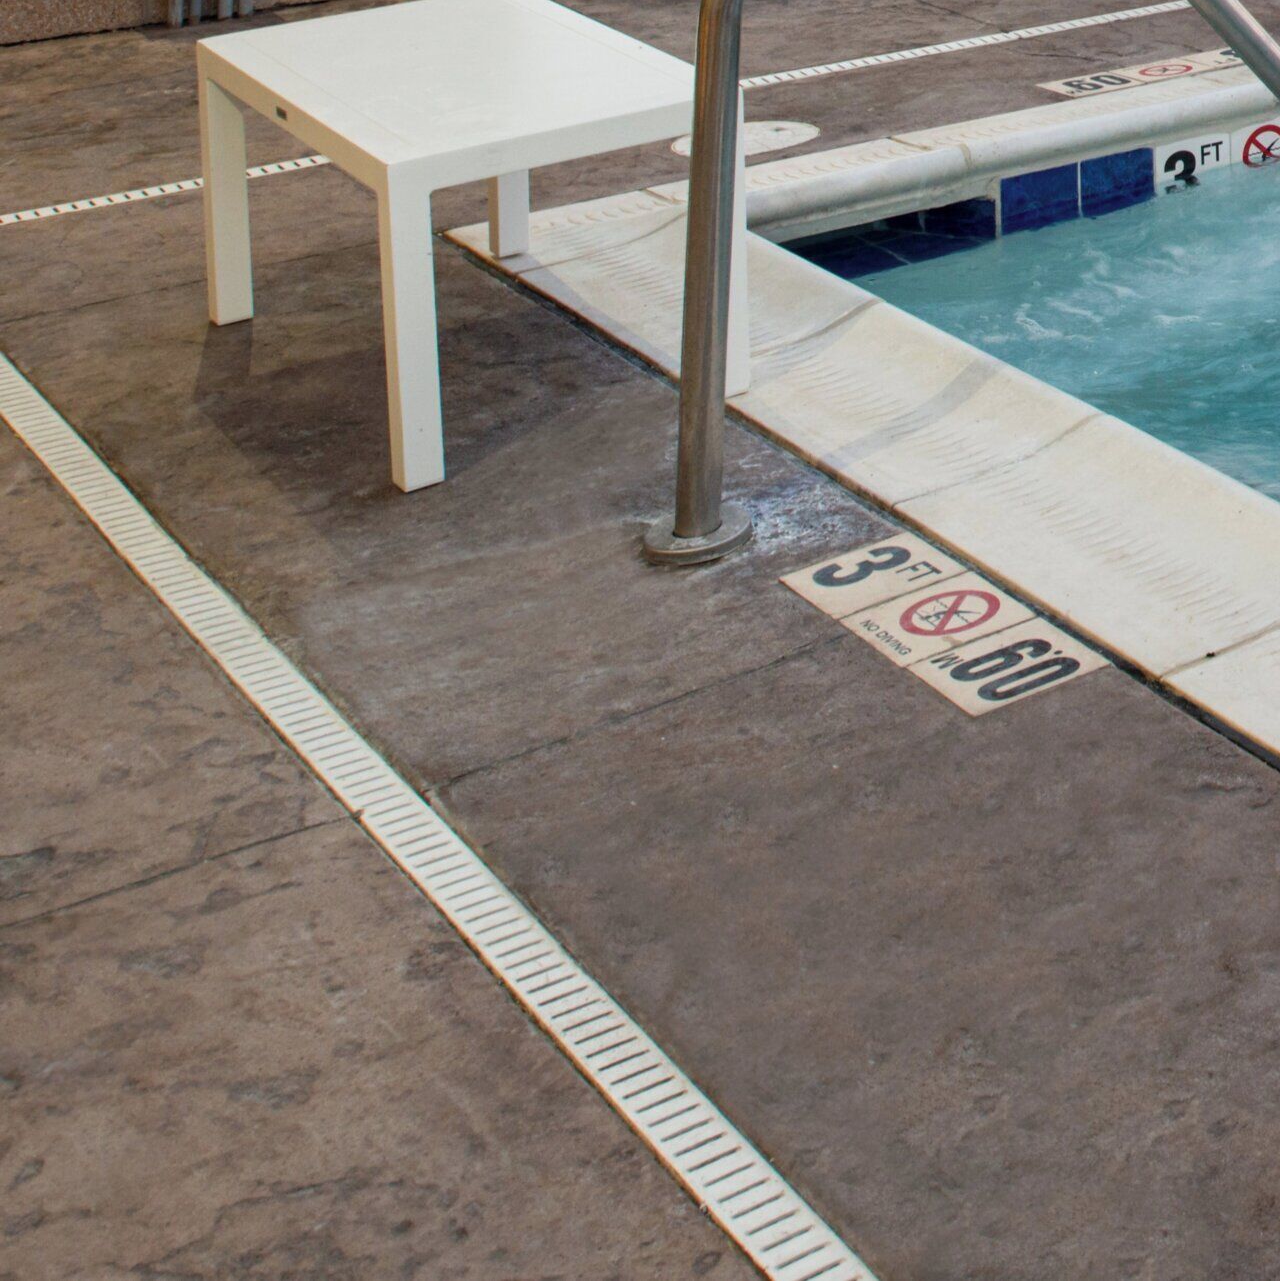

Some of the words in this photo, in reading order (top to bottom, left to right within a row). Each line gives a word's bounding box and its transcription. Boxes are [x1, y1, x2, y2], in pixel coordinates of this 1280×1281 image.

[1164, 150, 1200, 194] 3
[1201, 141, 1223, 165] FT
[812, 546, 912, 587] 3
[896, 560, 942, 582] FT
[860, 619, 880, 631] NO
[876, 630, 912, 655] DIVING
